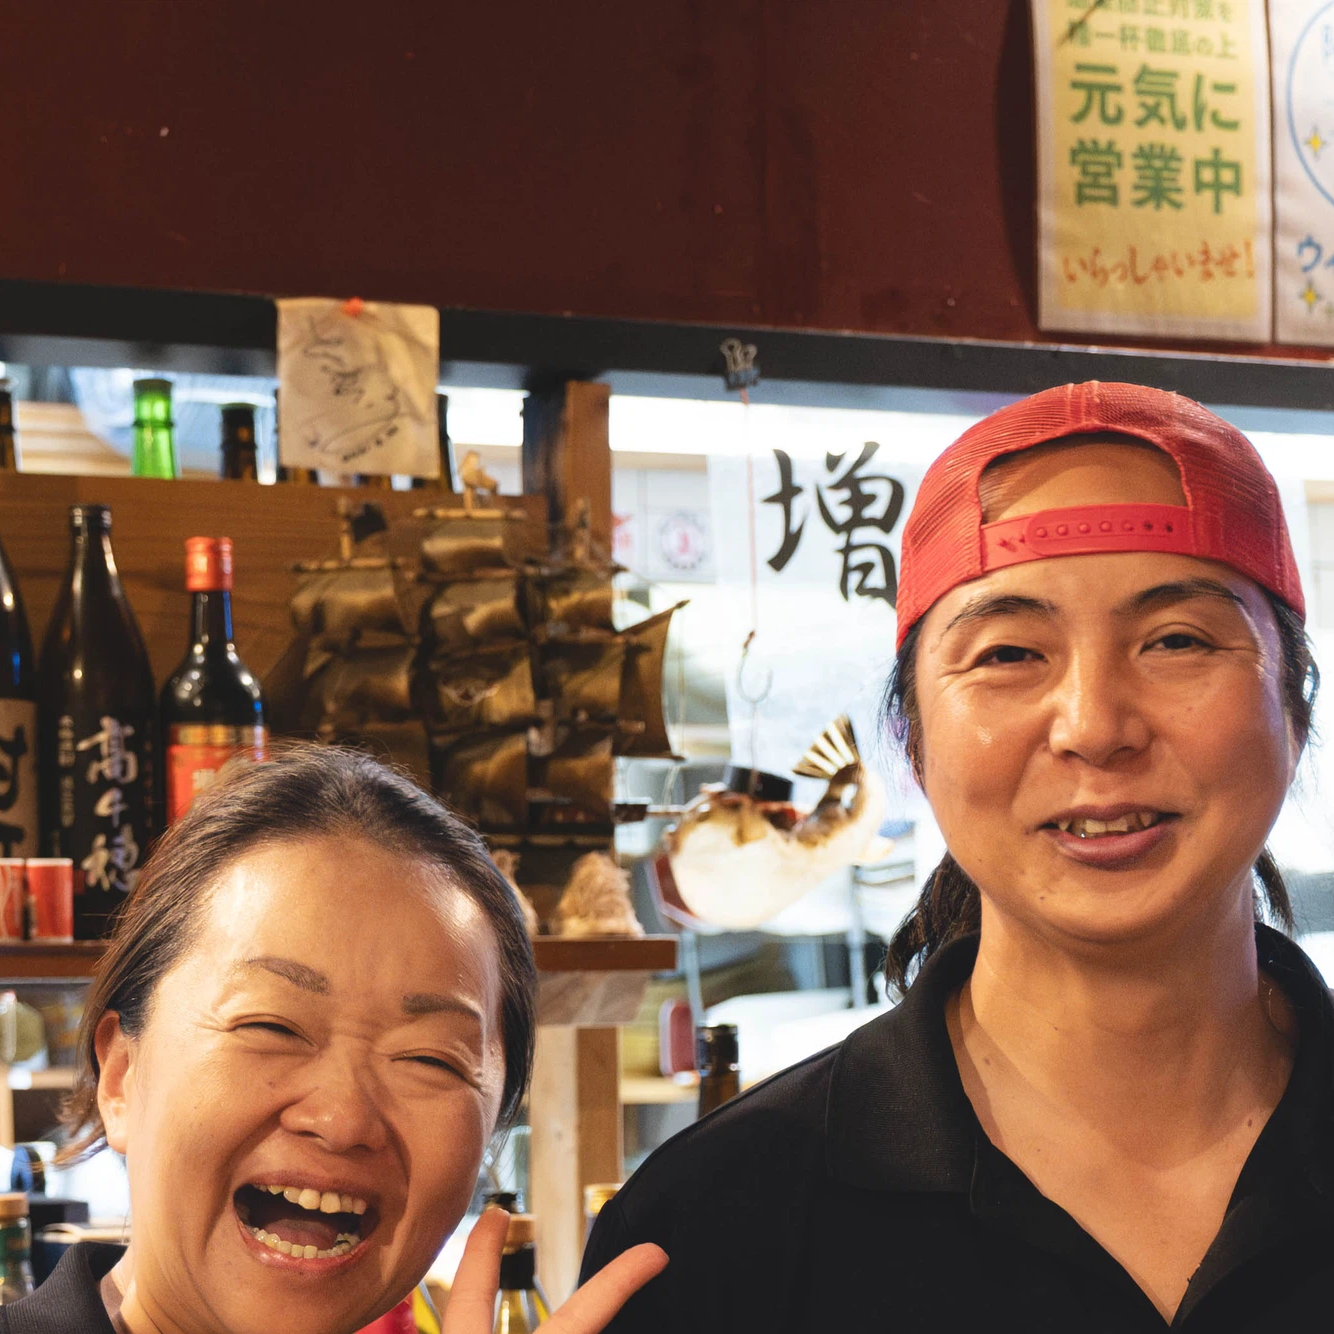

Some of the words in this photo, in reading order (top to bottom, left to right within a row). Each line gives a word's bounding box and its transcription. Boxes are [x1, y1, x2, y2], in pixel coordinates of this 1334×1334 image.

[1069, 61, 1241, 132] 元気に
[1069, 139, 1243, 214] 営業中
[762, 441, 904, 608] 増
